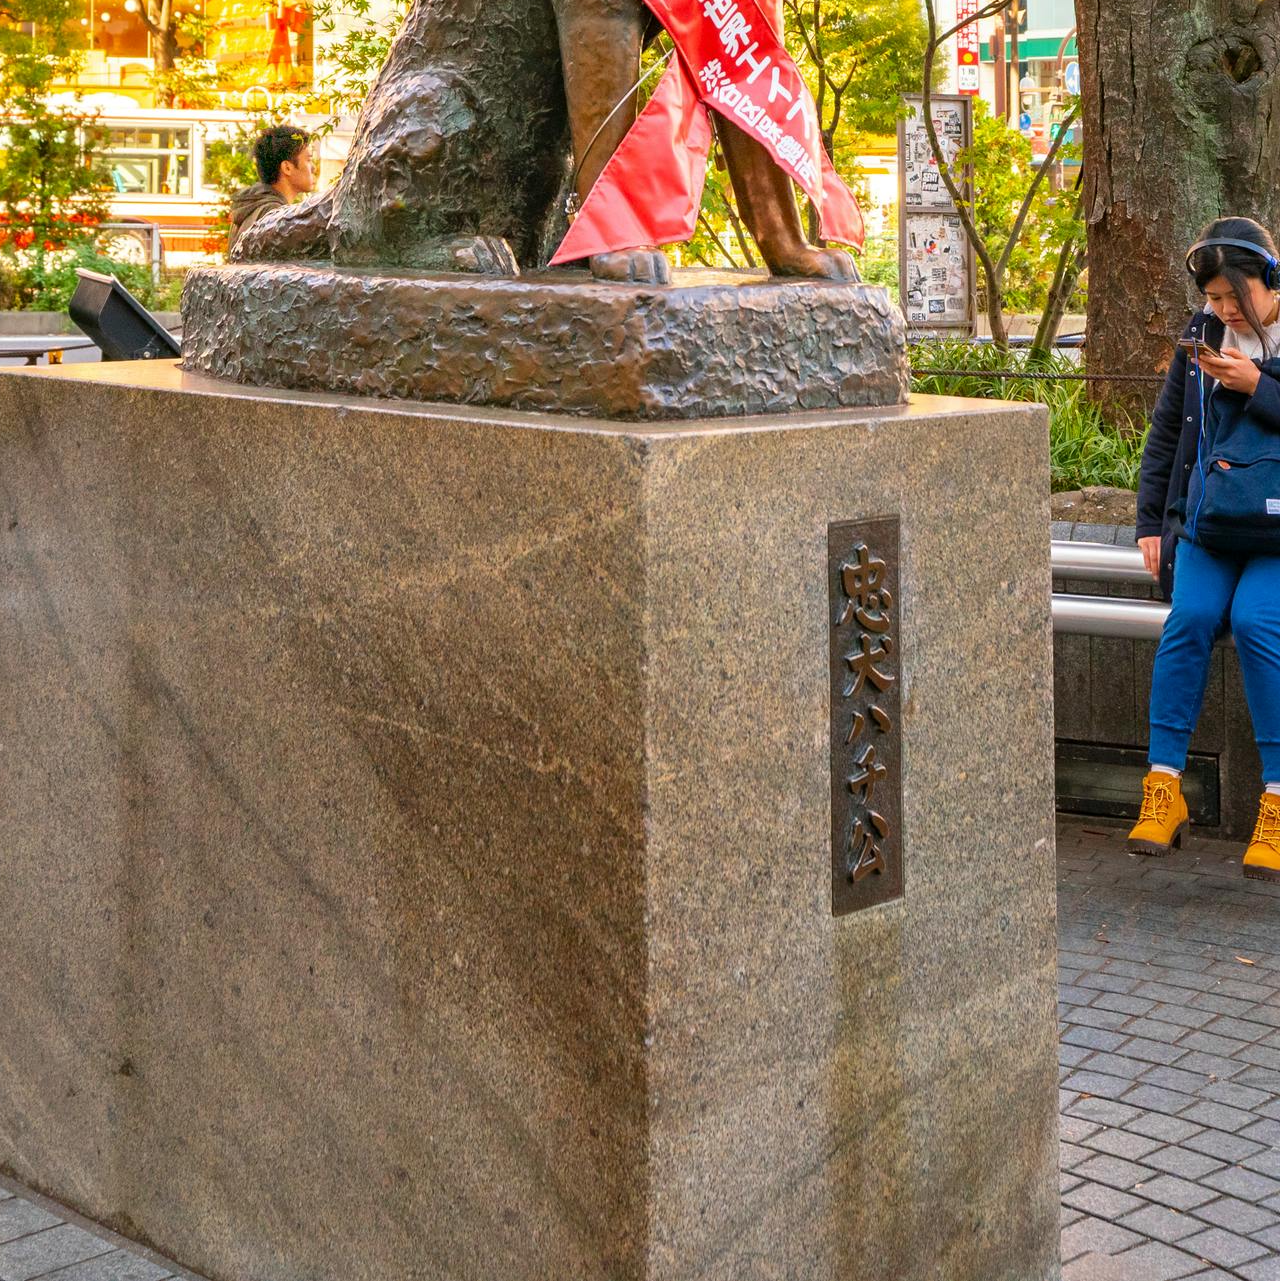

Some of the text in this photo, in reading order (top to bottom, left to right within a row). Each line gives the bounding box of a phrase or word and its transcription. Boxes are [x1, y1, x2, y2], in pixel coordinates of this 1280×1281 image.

[837, 543, 895, 884] 忠犬ハチ公
